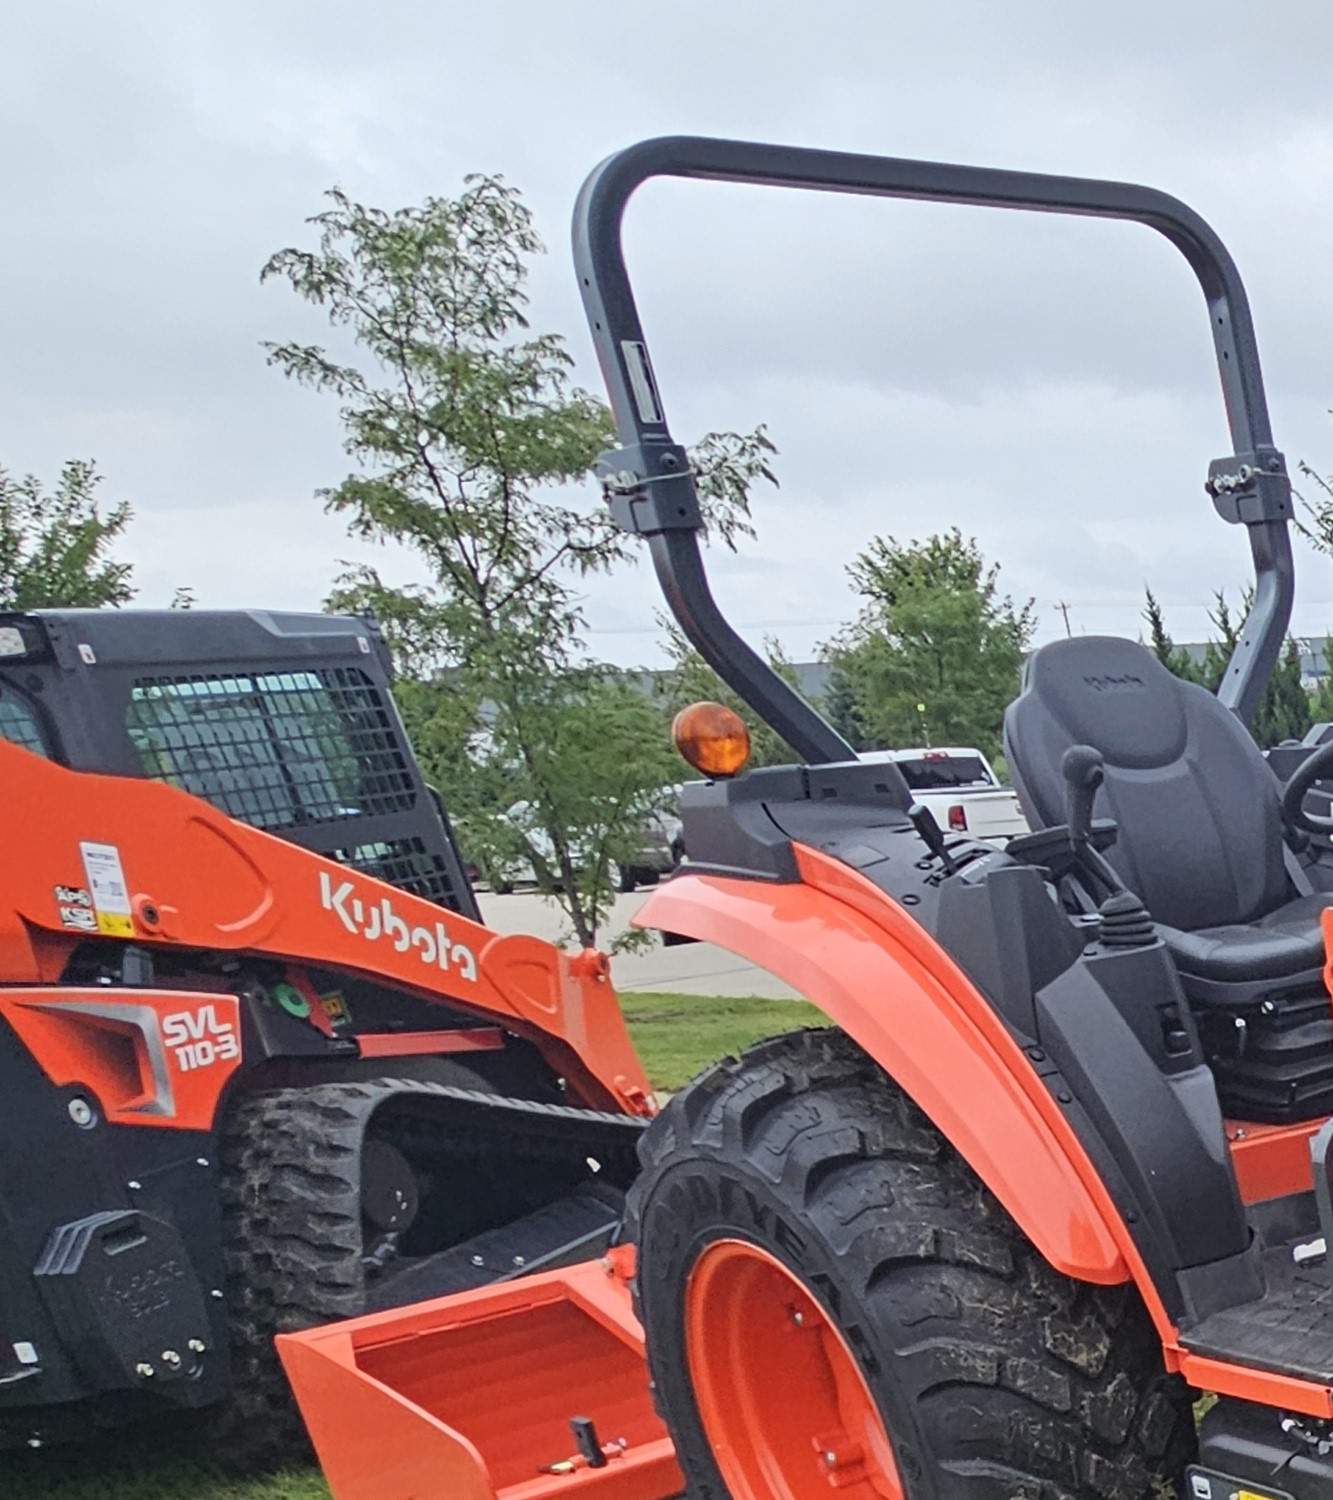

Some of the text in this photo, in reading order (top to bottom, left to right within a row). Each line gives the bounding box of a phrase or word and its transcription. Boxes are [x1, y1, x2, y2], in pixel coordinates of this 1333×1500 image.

[319, 870, 478, 983] Kubota
[162, 1004, 232, 1047] SVL
[175, 1033, 239, 1072] 110-3
